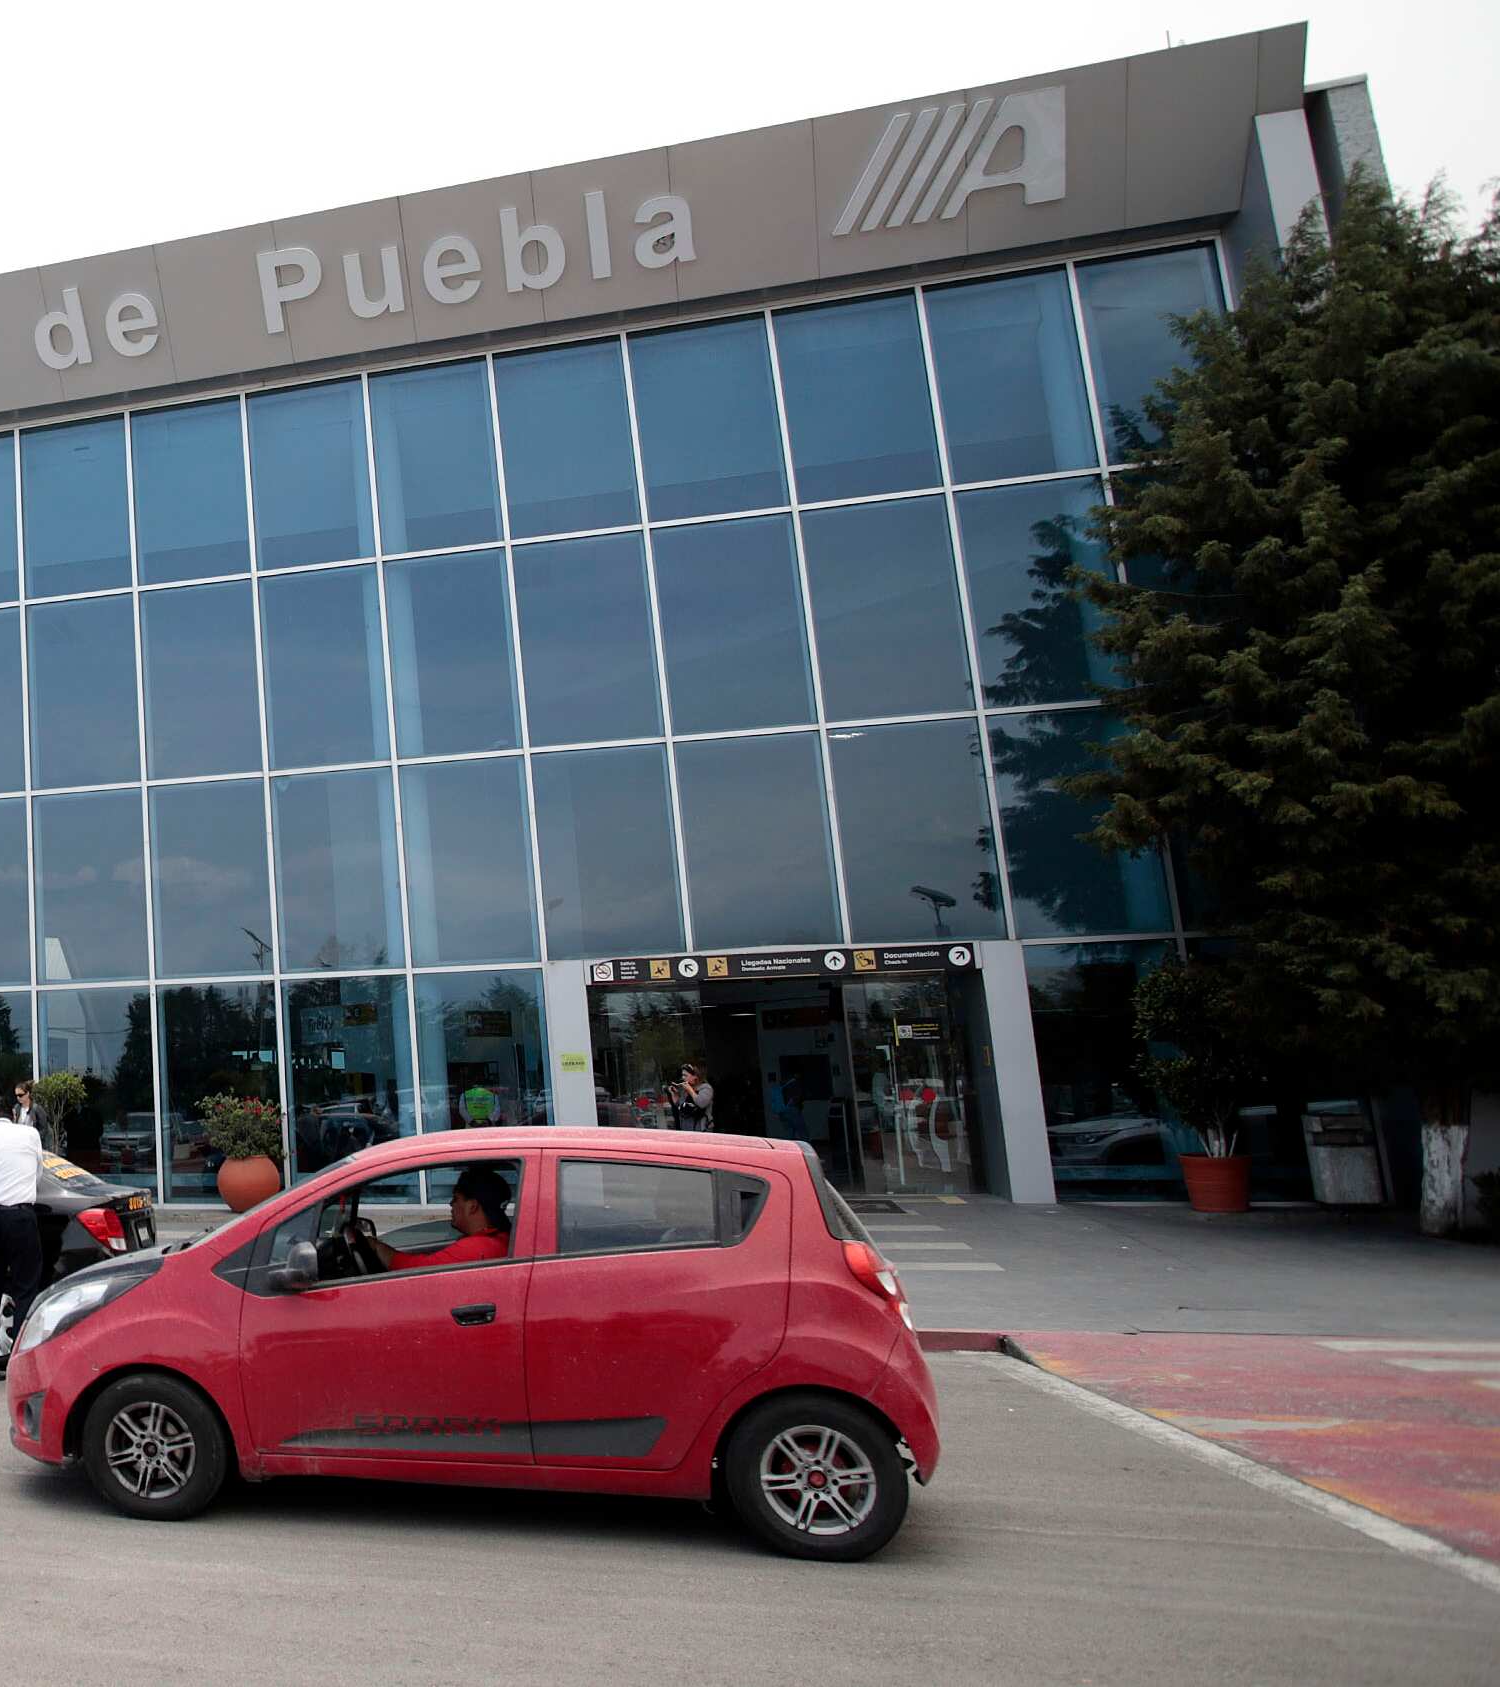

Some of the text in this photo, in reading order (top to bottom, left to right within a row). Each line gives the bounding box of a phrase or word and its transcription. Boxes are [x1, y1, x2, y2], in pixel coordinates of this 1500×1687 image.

[34, 286, 159, 371] de
[256, 189, 697, 334] Puebla
[883, 950, 940, 959] Documentación
[741, 957, 811, 967] Llegadas Nacionales
